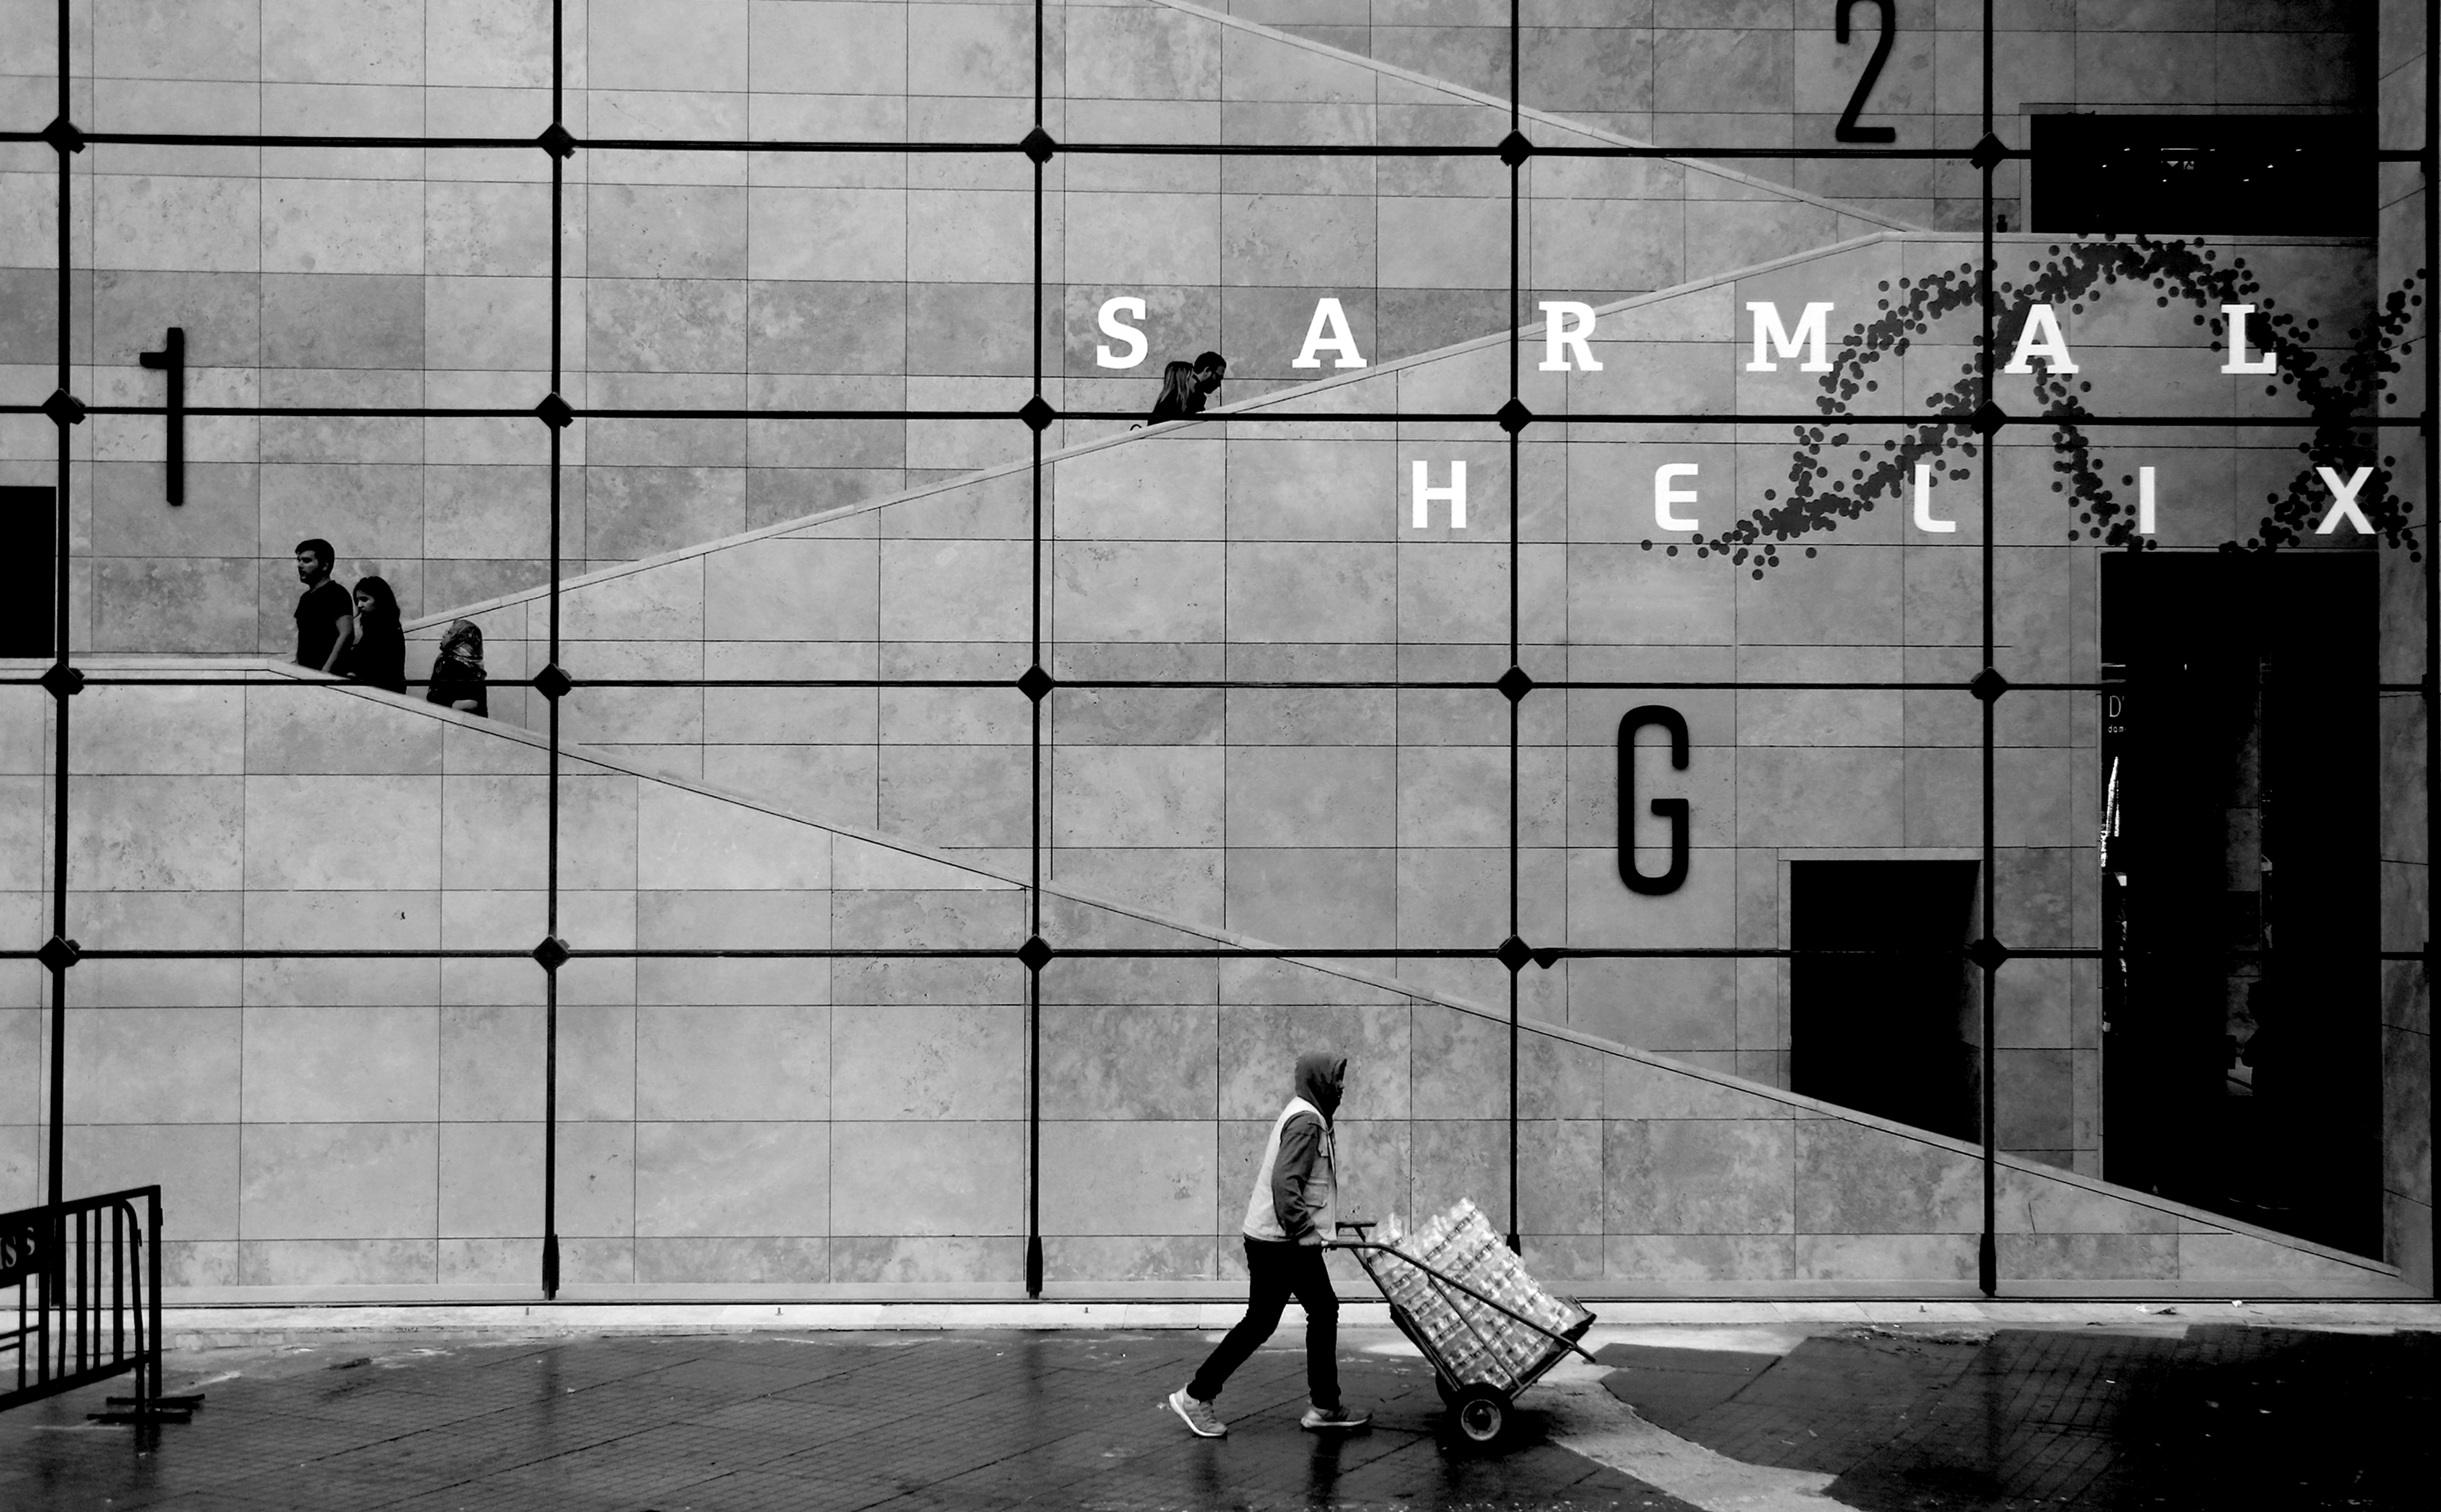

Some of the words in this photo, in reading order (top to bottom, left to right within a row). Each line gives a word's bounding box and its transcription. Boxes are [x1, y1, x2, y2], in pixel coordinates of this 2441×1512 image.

[1835, 0, 1895, 143] 2
[1096, 296, 2277, 374] SARMAL
[139, 327, 184, 506] 1
[1412, 460, 2376, 534] HELIX
[1618, 705, 1689, 895] G
